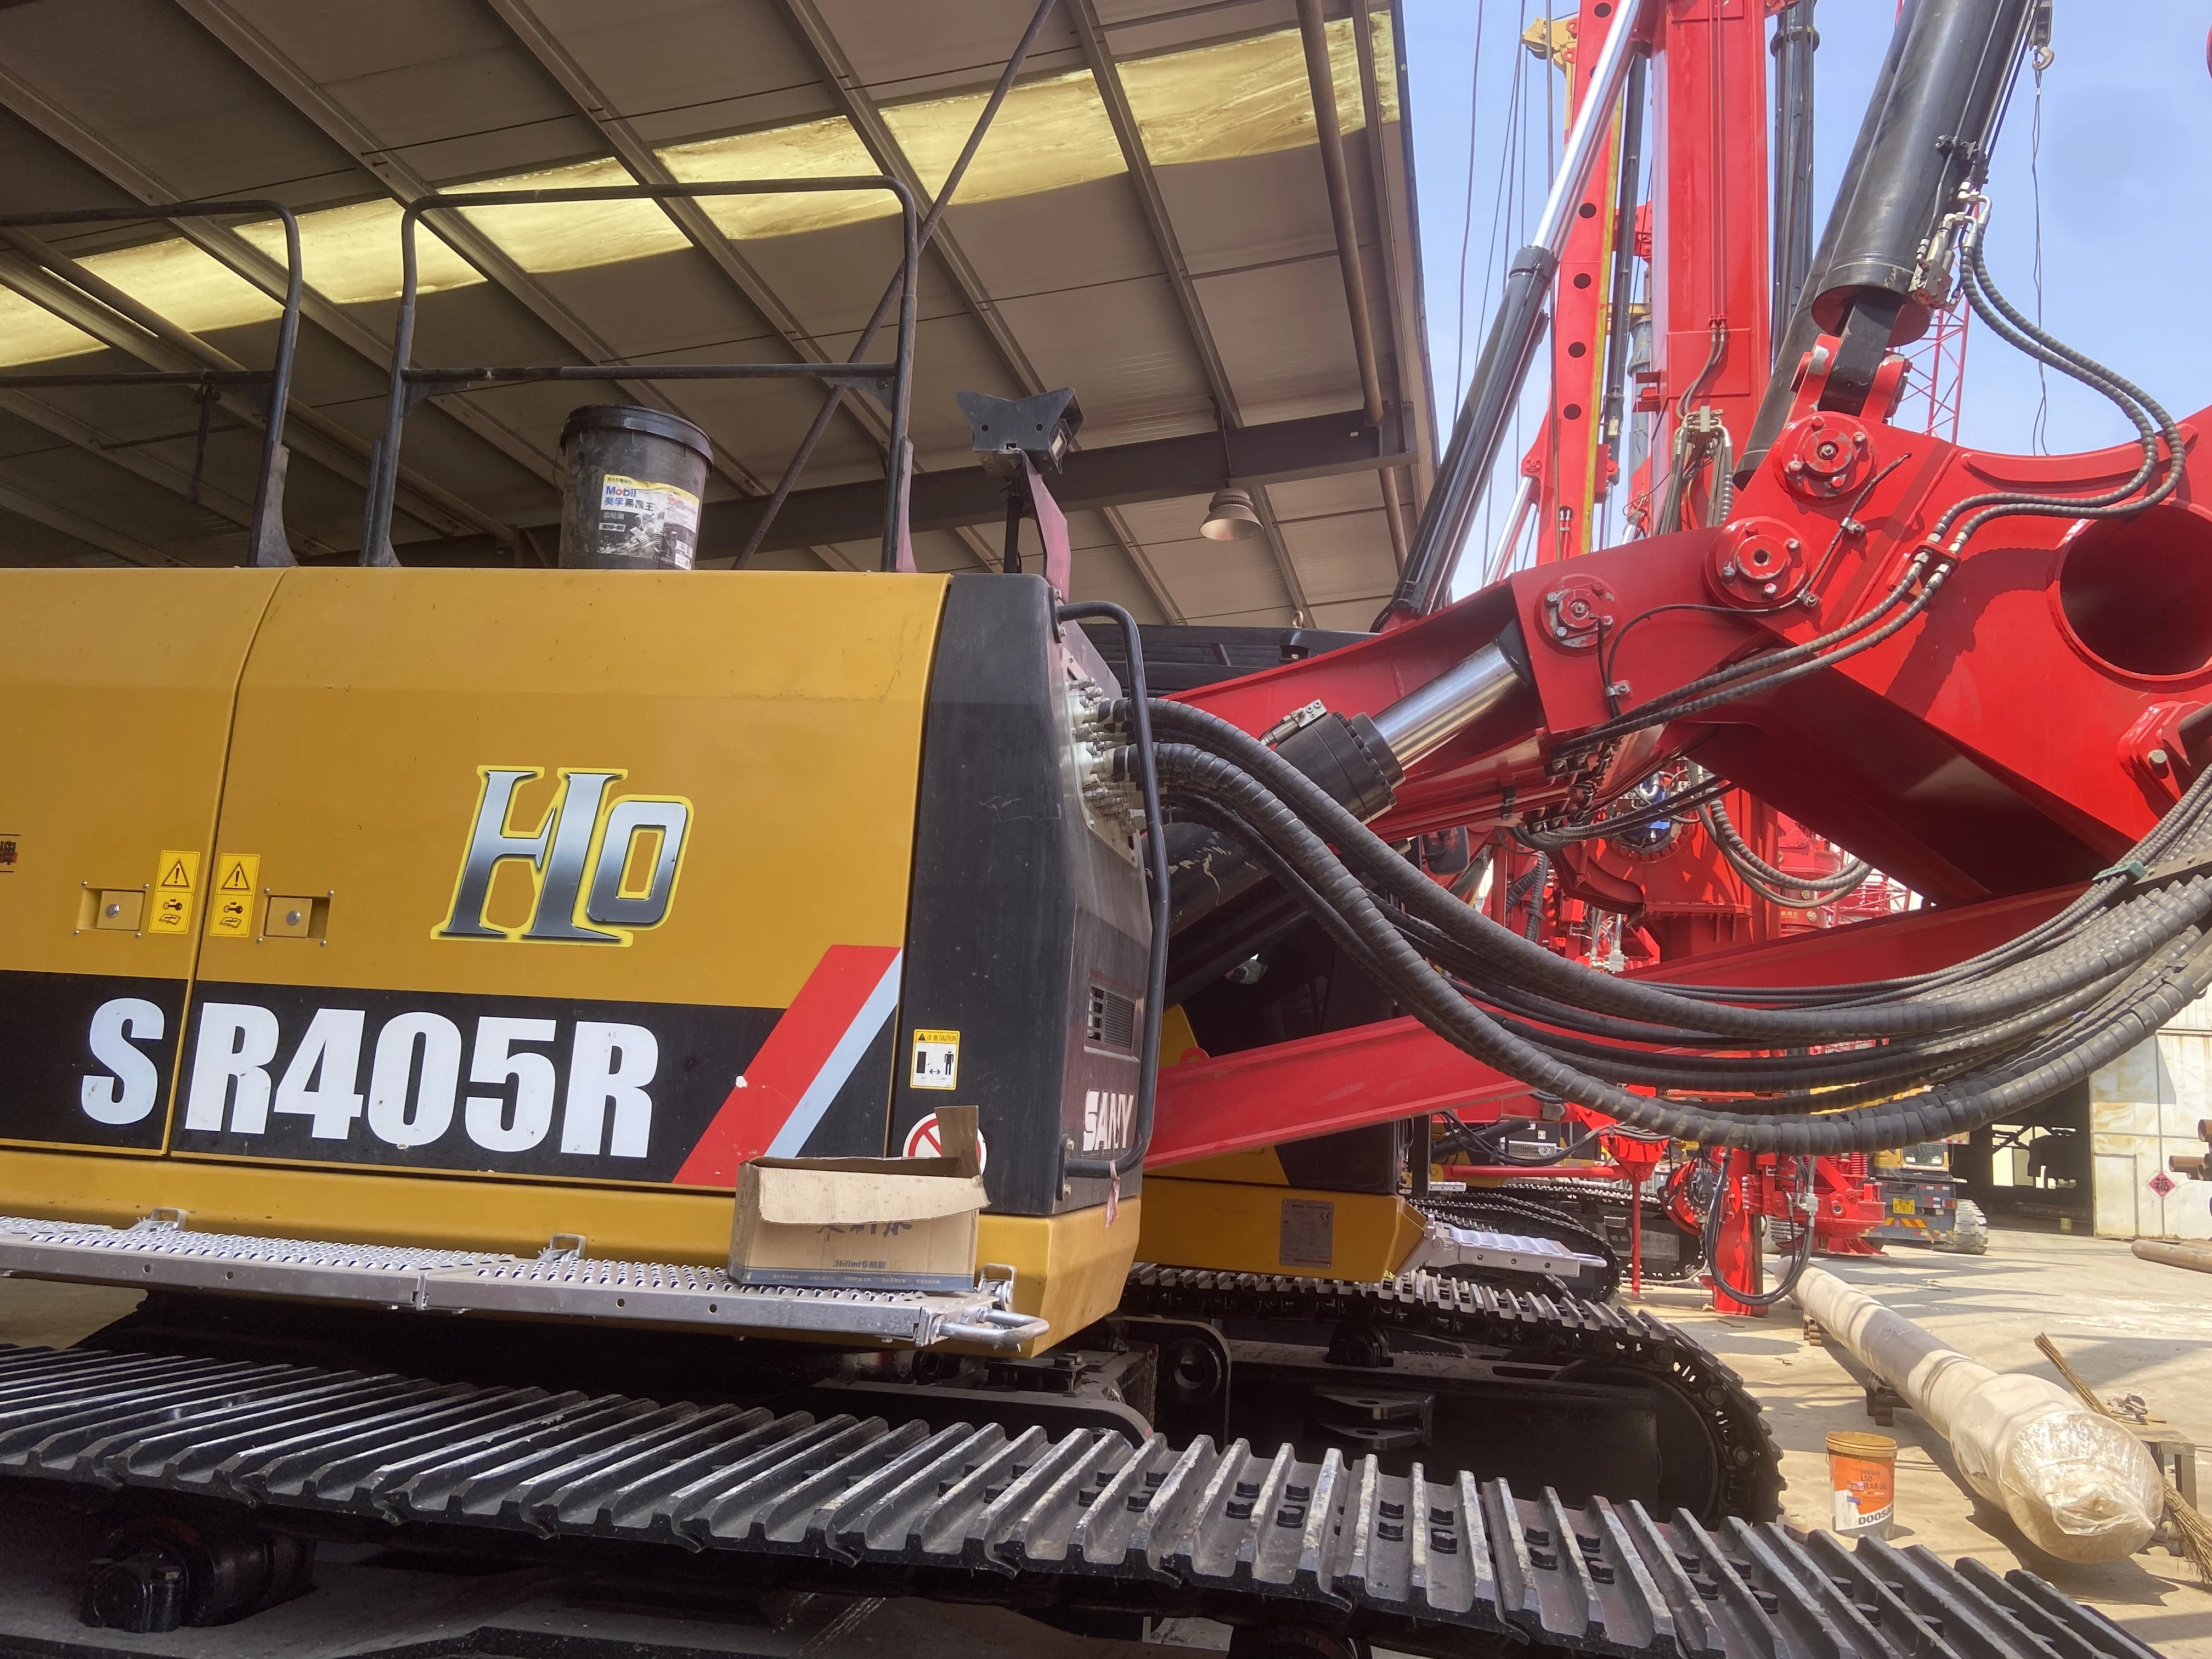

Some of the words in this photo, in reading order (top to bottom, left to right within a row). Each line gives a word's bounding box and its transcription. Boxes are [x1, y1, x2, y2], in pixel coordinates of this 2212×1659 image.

[606, 486, 637, 498] Mobil
[603, 511, 624, 520] 齿轮油
[1082, 1090, 1135, 1153] SANY
[2154, 1177, 2169, 1192] 福
[1894, 1204, 1914, 1212] E7817
